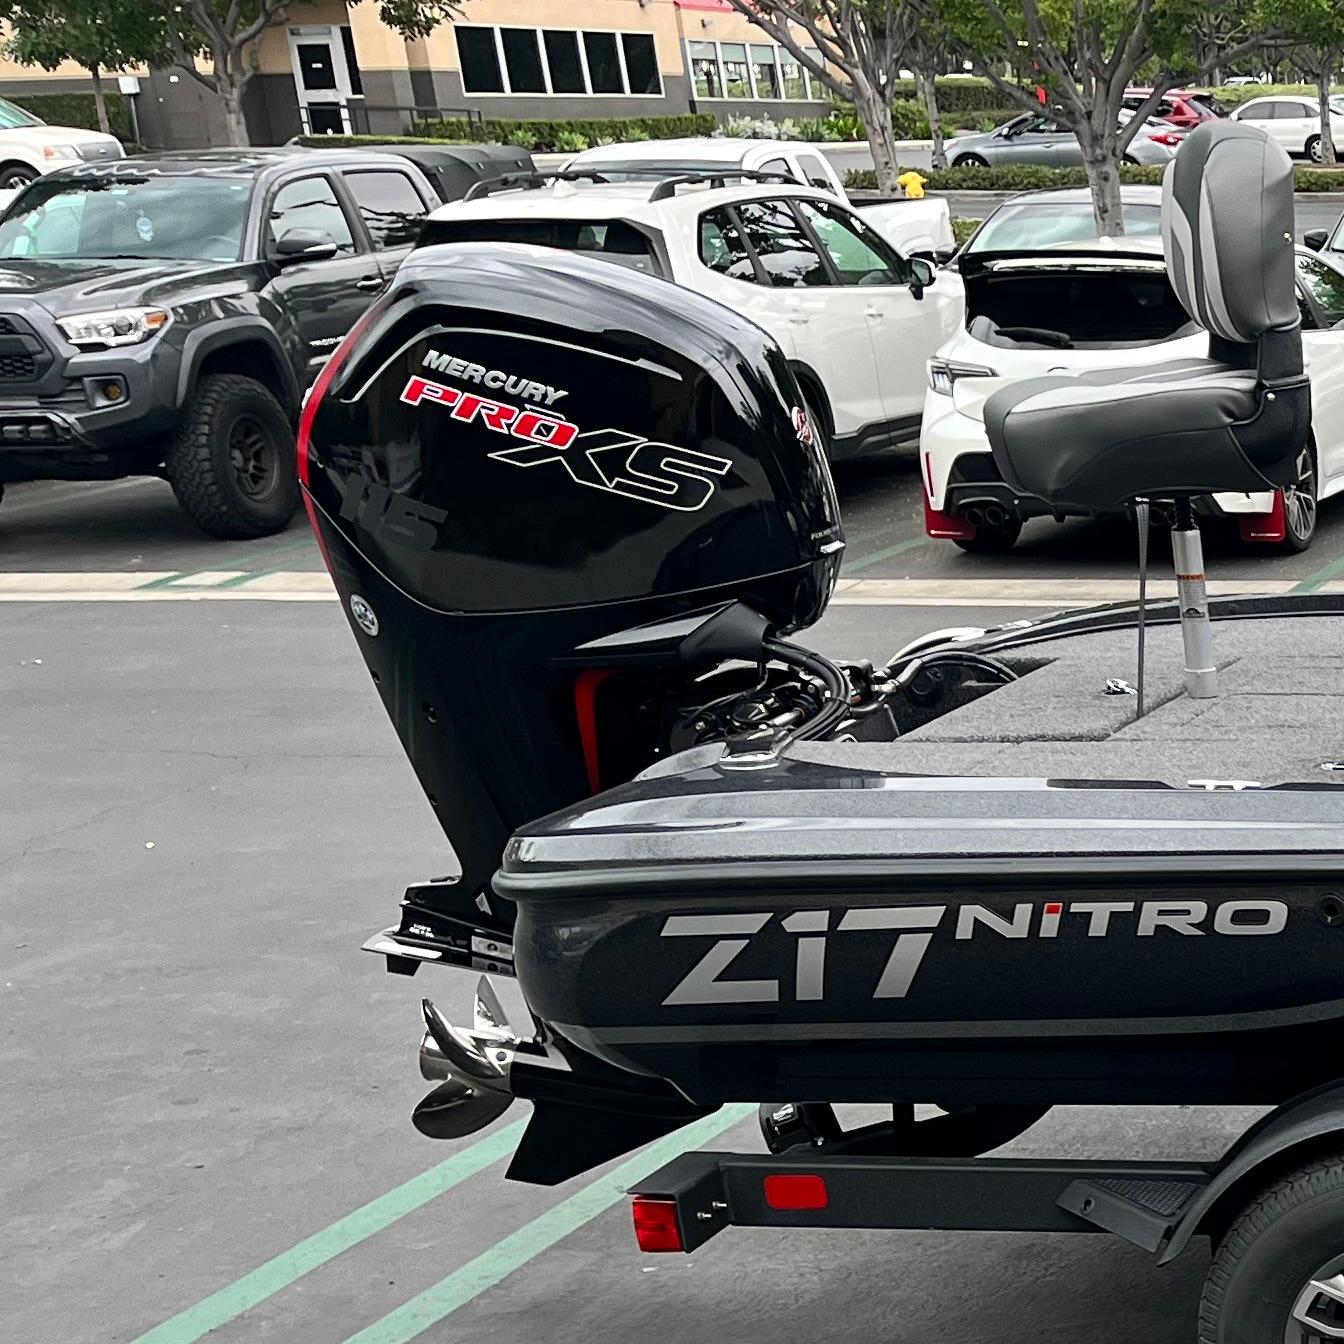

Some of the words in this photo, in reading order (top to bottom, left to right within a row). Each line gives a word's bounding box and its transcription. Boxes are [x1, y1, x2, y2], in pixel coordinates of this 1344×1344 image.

[399, 375, 579, 450] PRO
[421, 349, 569, 406] MERCURY
[487, 428, 734, 512] XS
[659, 905, 947, 1006] Z17
